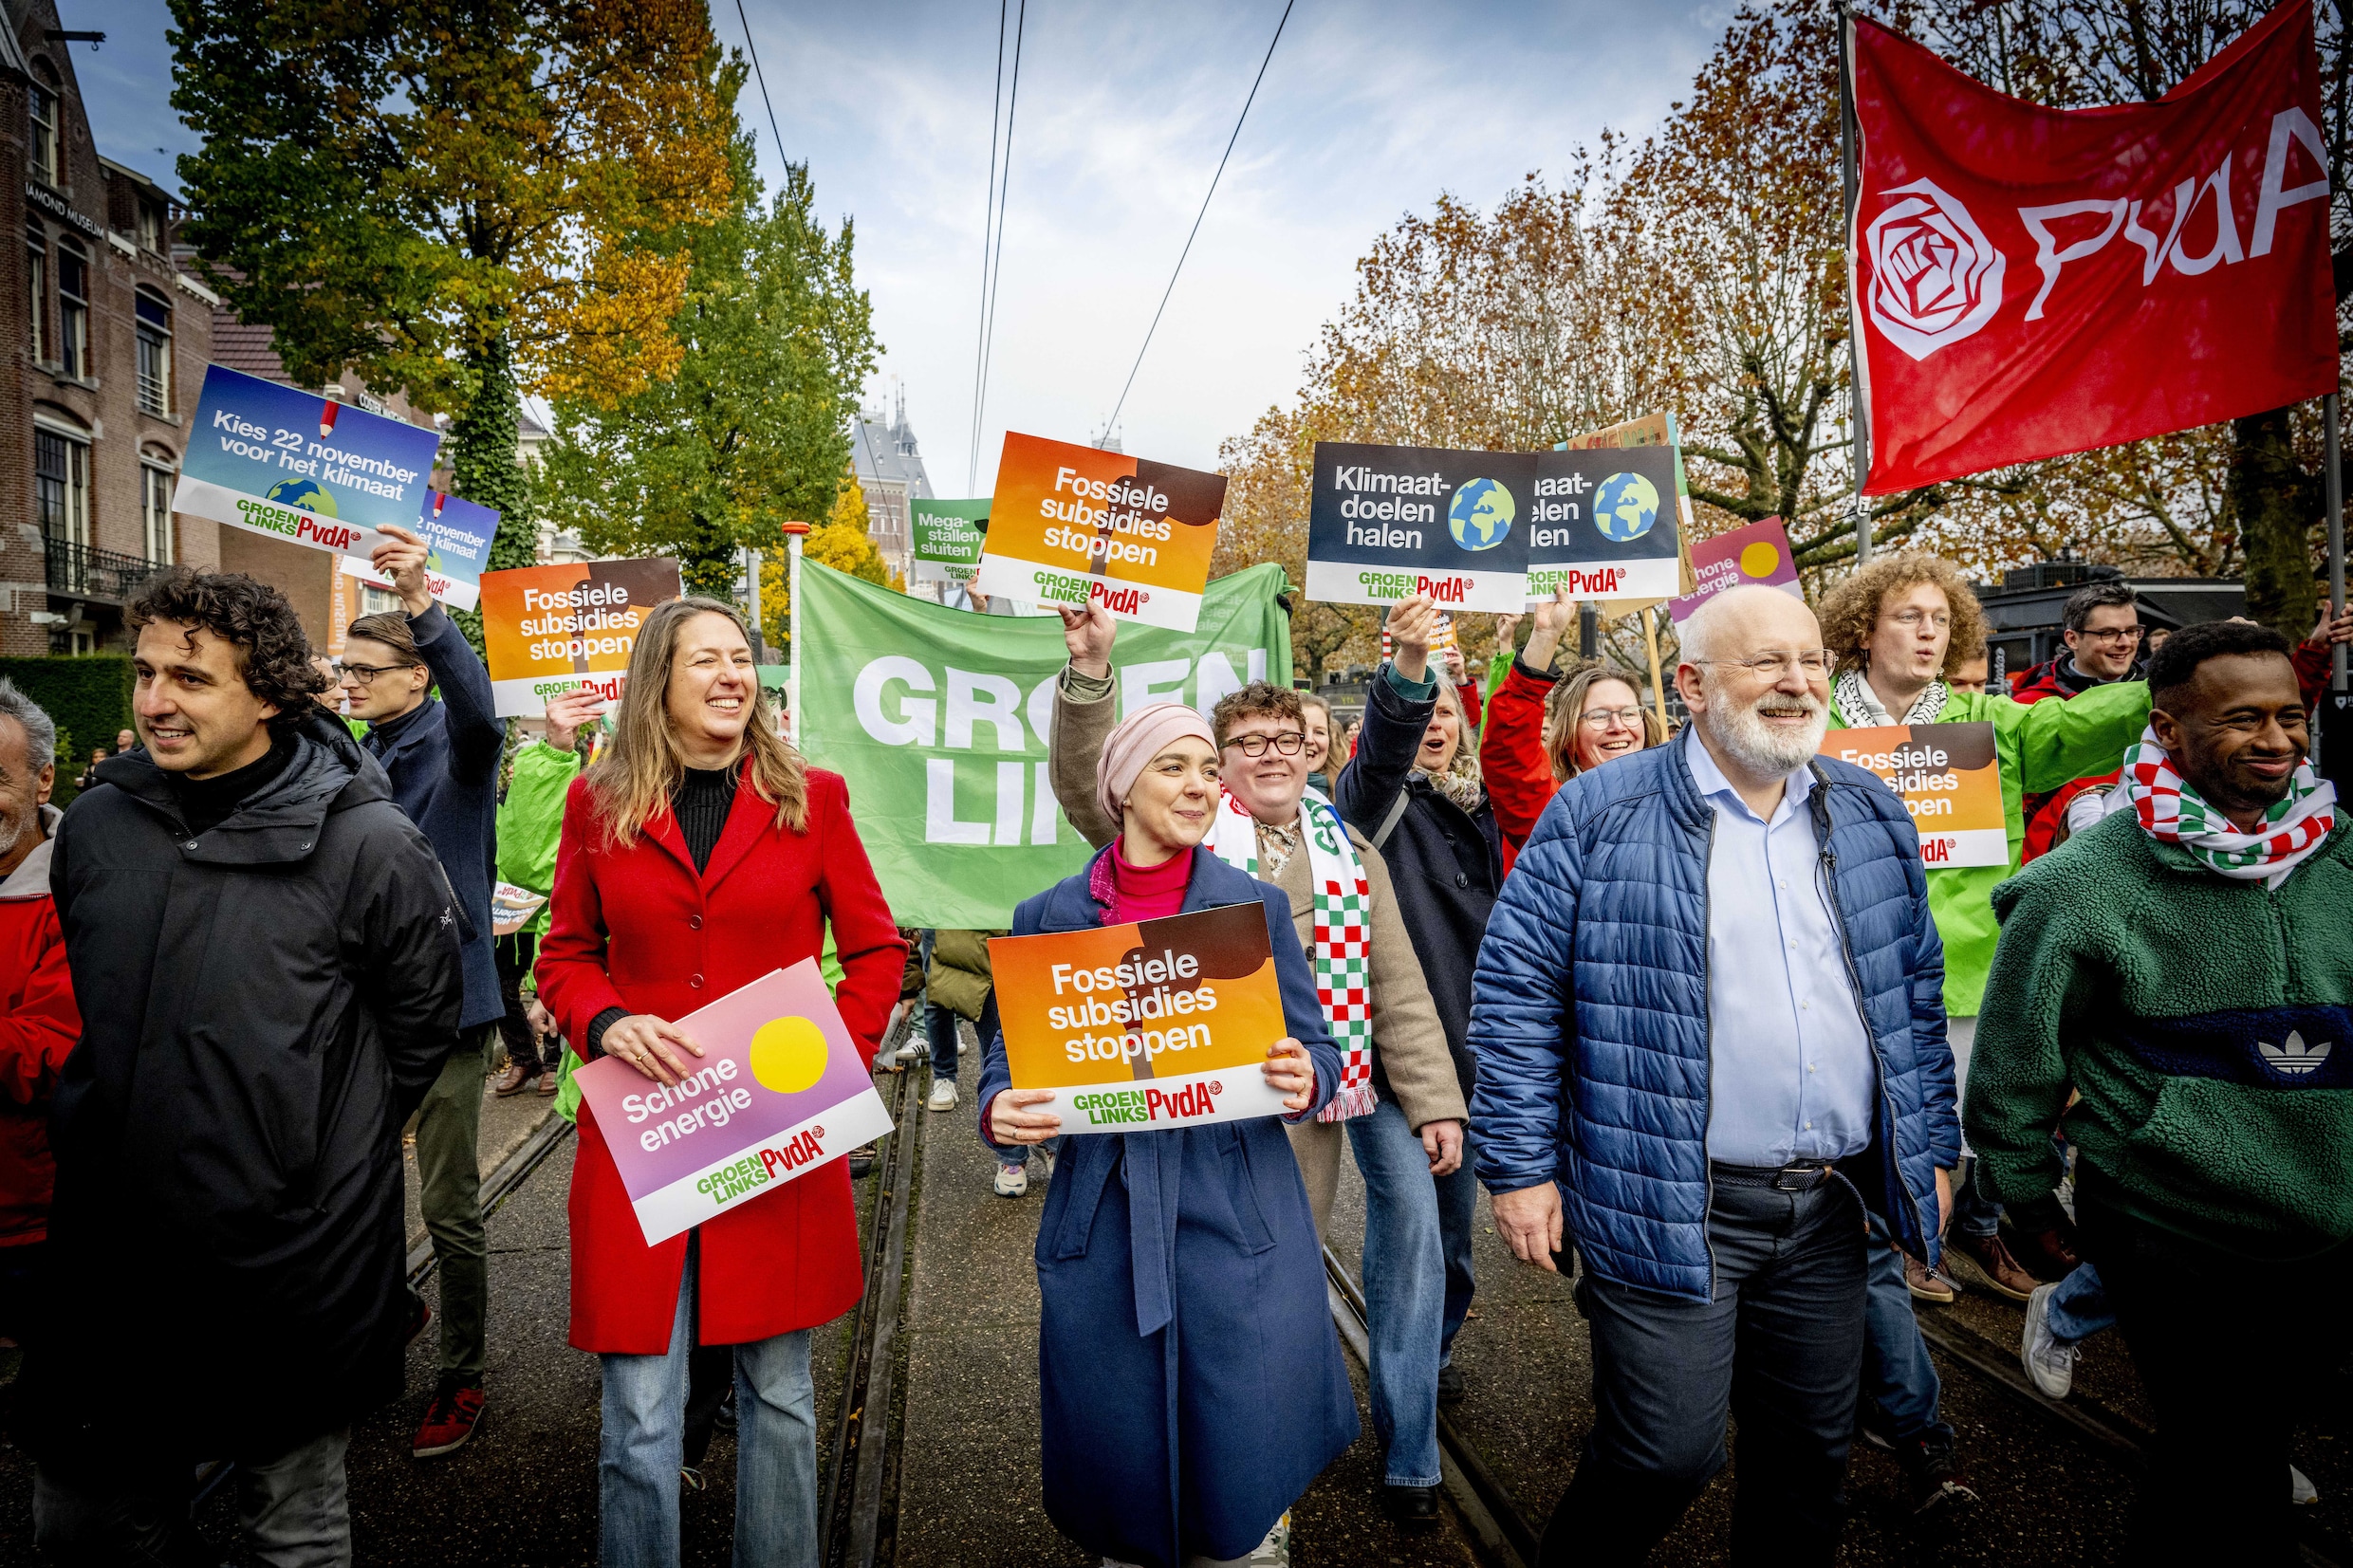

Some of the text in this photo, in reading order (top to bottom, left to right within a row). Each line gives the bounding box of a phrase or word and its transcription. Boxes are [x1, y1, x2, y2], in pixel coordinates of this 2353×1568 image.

[25, 181, 104, 240] IAMOND MUSEUM
[2017, 105, 2330, 323] PvdA
[213, 409, 418, 485] Kies 22 november
[220, 435, 404, 502] voor het klimaat
[1335, 465, 1452, 496] Klimaat-
[1054, 466, 1169, 513] Fossiele
[236, 498, 301, 526] GROEN
[244, 512, 297, 536] LINKS
[917, 512, 970, 531] Mega-
[1040, 497, 1172, 542] subsidies
[1340, 493, 1436, 524] doelen
[296, 516, 350, 549] PvdA
[416, 515, 486, 548] 2 november
[416, 531, 478, 561] et klimaat
[928, 528, 980, 543] stallen
[1043, 526, 1158, 567] stoppen
[1346, 521, 1423, 549] halen
[1529, 525, 1569, 547] len
[920, 542, 972, 557] sluiten
[944, 565, 976, 575] GROEN
[1033, 571, 1093, 592] GROEN
[1359, 571, 1417, 587] GROEN
[1527, 570, 1568, 584] ROEN
[1568, 567, 1618, 594] PvdA
[1694, 557, 1735, 581] hone
[523, 581, 629, 612] Fossiele
[1040, 586, 1089, 604] LINKS
[1090, 581, 1139, 616] PvdA
[1417, 576, 1465, 603] PvdA
[520, 607, 640, 637] subsidies
[529, 636, 633, 662] stoppen
[853, 649, 1267, 751] GREN
[1841, 745, 1949, 770] Fossiele
[1883, 769, 1959, 793] sidies
[1050, 949, 1199, 995] Fossiele
[1048, 985, 1218, 1030] subsidies
[1065, 1022, 1212, 1065] stoppen
[621, 1058, 738, 1124] Schone
[1073, 1090, 1146, 1111] GROEN
[1145, 1081, 1215, 1120] PvdA
[639, 1087, 752, 1153] energie
[1087, 1106, 1149, 1125] LINKS
[759, 1130, 824, 1179] PvdA
[696, 1153, 765, 1194] GROEN
[712, 1168, 769, 1206] LINKS
